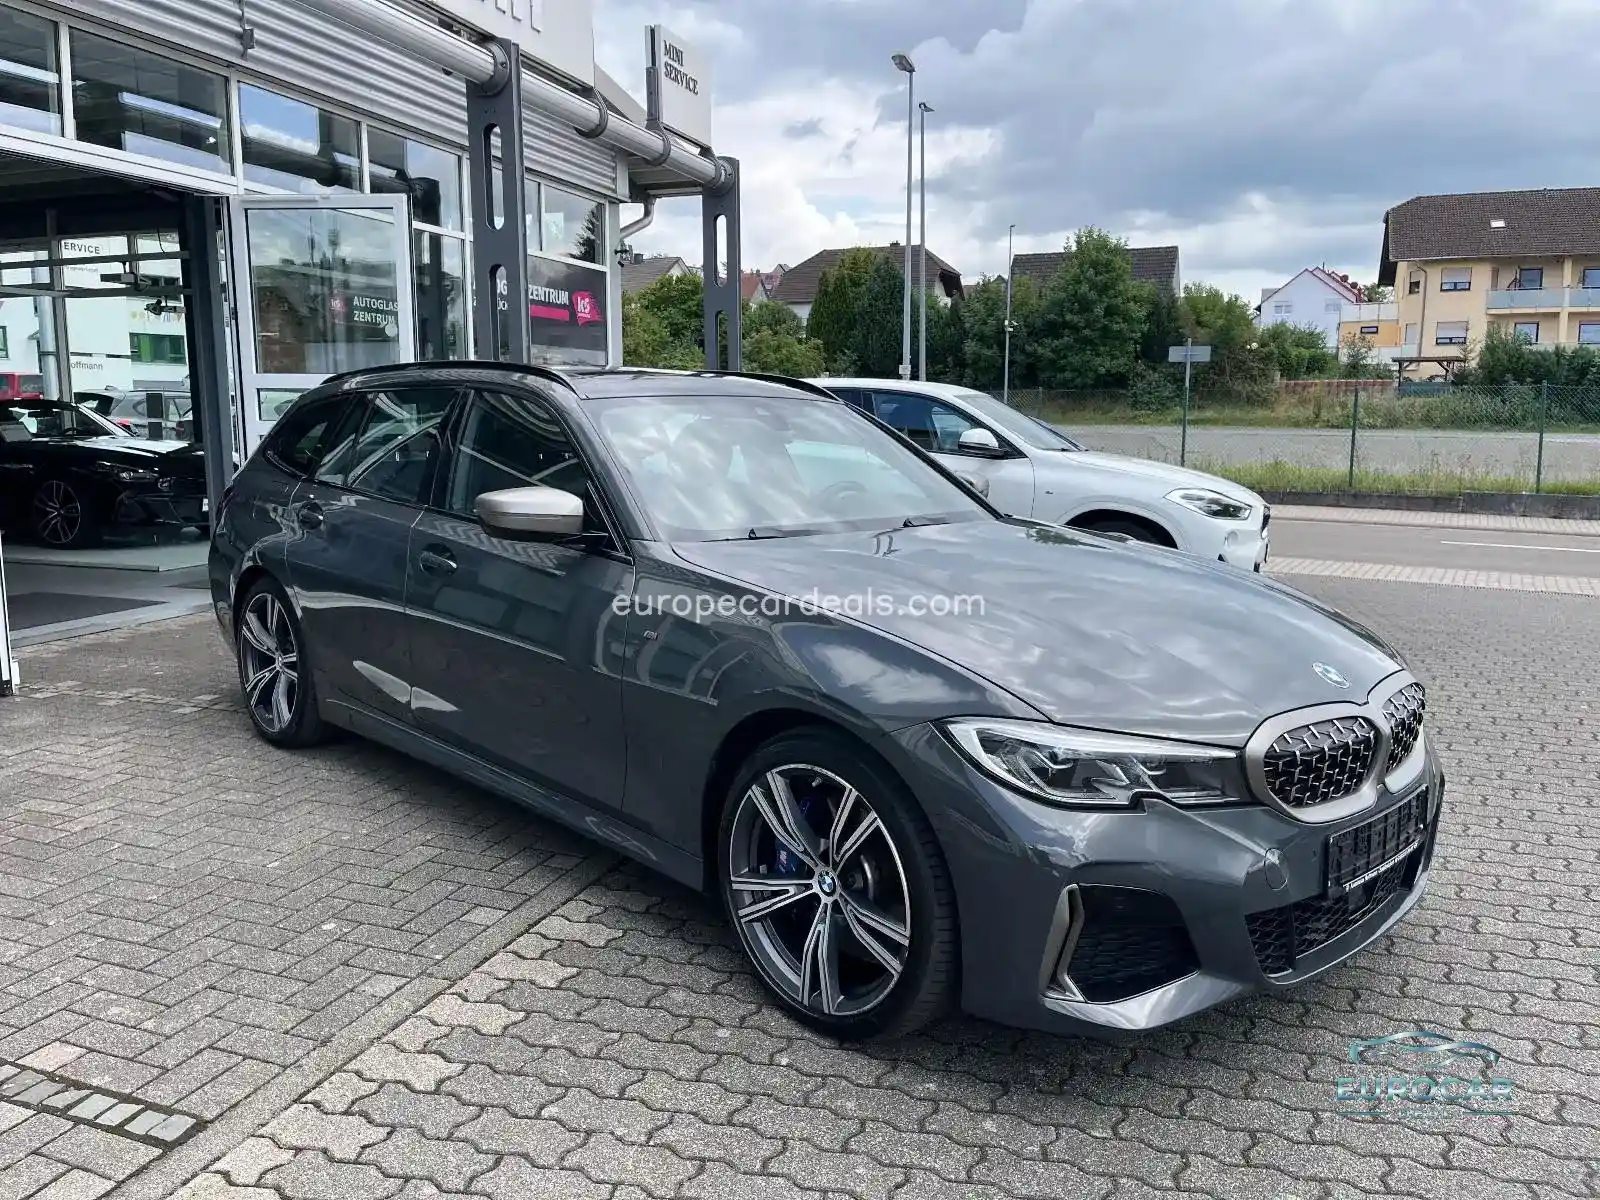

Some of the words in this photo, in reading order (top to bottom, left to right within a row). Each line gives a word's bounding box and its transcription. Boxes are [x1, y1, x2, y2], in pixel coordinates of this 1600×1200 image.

[663, 39, 684, 67] MINI
[664, 60, 699, 96] SERVICE
[63, 241, 101, 255] ERVICE
[353, 295, 399, 311] AUTOGLAS
[528, 284, 569, 306] ZENTRUM
[353, 310, 395, 325] ZENTRUM
[70, 361, 104, 371] offmann
